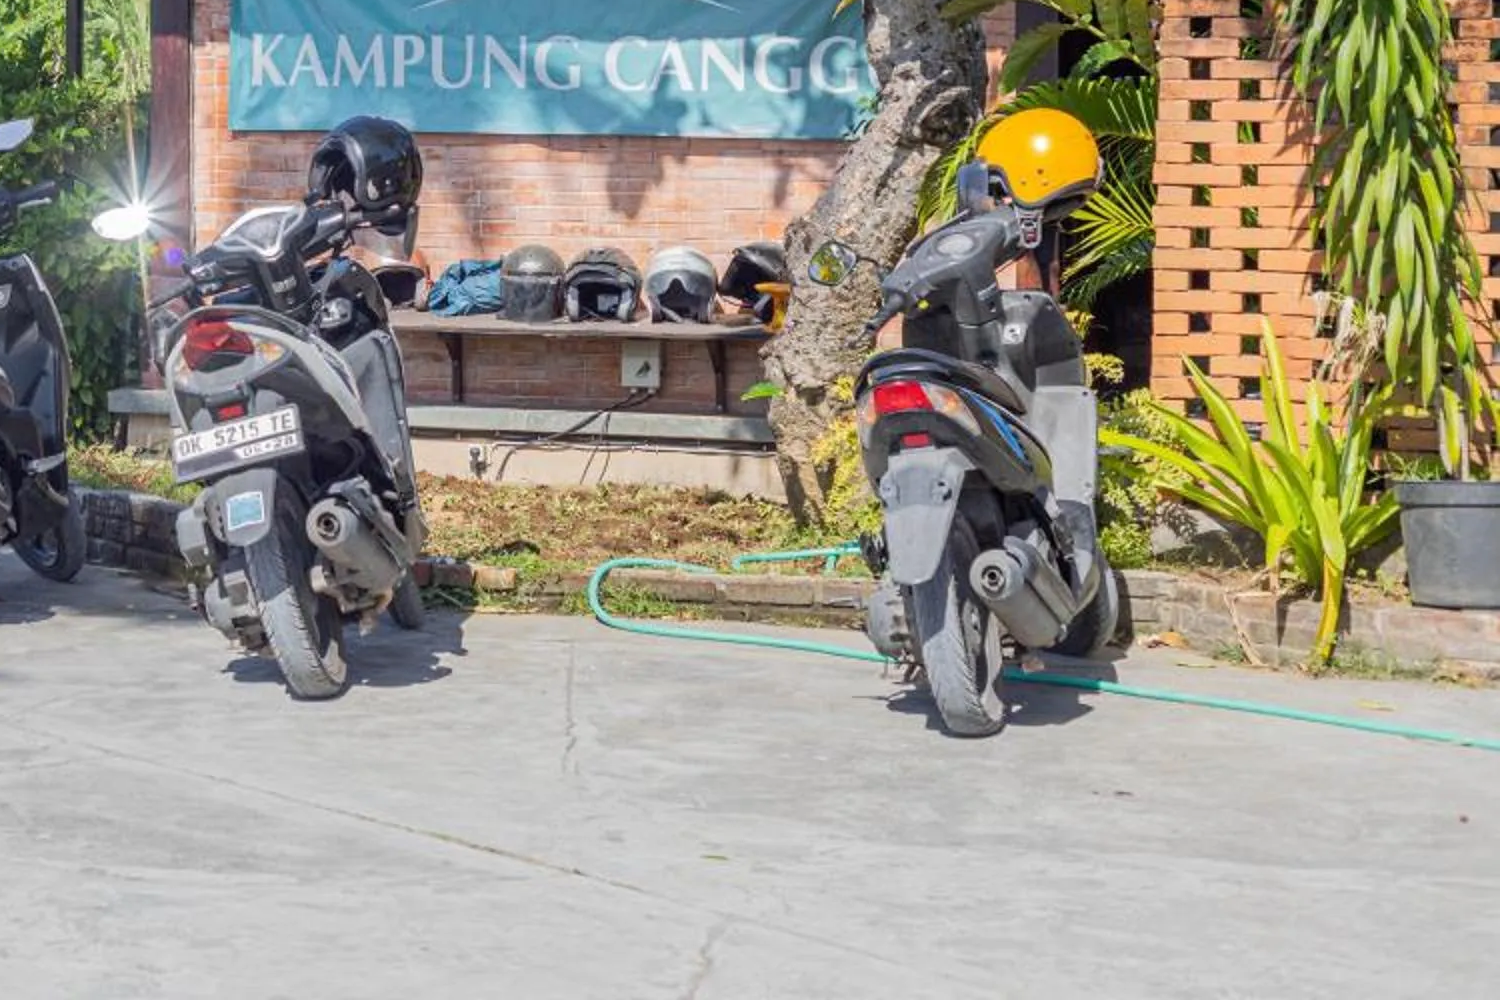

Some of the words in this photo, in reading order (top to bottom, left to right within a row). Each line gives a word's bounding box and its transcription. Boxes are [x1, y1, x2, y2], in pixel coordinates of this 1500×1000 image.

[251, 33, 582, 92] KAMPUNG
[604, 35, 880, 93] CANGG
[179, 435, 203, 457] DK
[214, 422, 258, 446] 5215
[270, 412, 293, 431] TE
